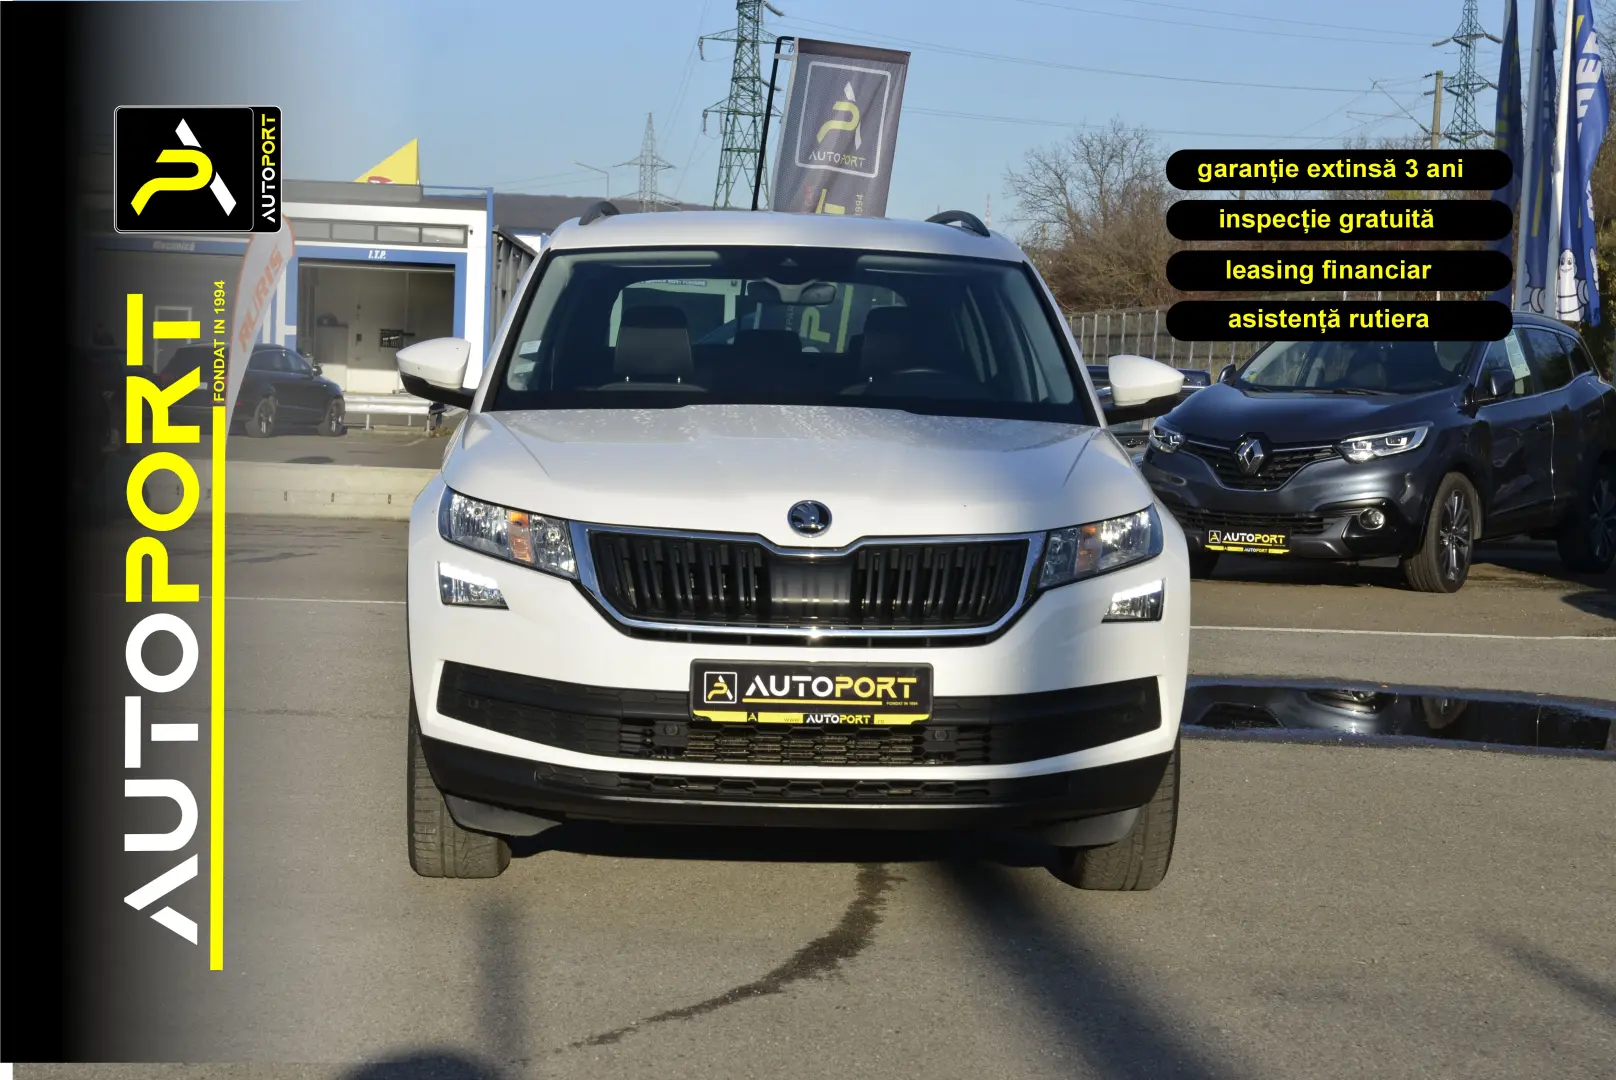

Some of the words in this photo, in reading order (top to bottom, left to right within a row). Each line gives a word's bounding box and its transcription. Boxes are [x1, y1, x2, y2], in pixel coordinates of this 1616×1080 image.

[808, 152, 866, 167] AUTOPORT
[238, 244, 283, 353] RURIS
[1223, 532, 1285, 544] AUTOPORT
[745, 675, 916, 698] AUTOPORT
[805, 714, 871, 724] AUTOPORT
